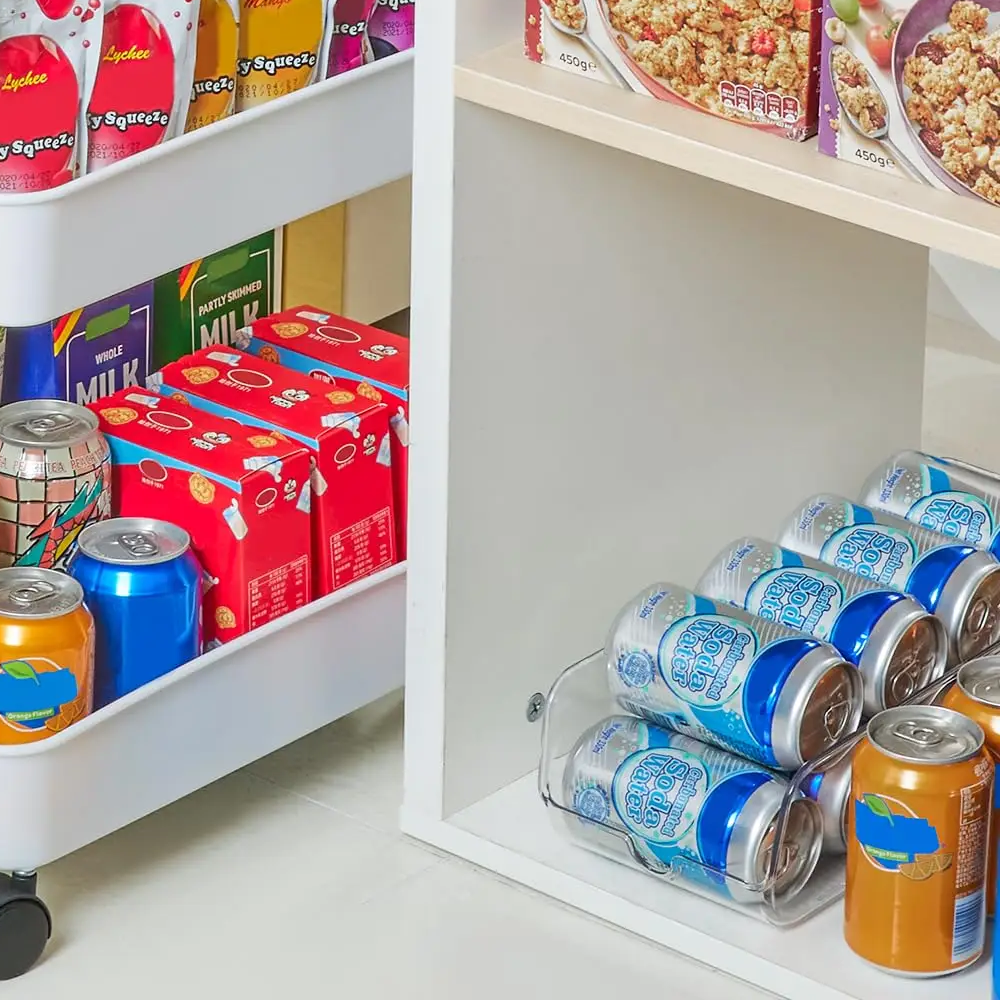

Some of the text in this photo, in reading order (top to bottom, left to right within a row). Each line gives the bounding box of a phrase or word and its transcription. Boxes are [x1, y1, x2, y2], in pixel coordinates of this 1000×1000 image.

[103, 45, 151, 65] Lychee
[253, 51, 317, 75] Squeeze
[2, 70, 48, 92] Lychee
[12, 132, 75, 159] Squeeze
[104, 110, 169, 132] Squeeze
[198, 279, 262, 317] PARTLY SKIMMED
[200, 300, 259, 349] MILK
[95, 344, 124, 365] WHOLE
[76, 358, 140, 406] MILK
[758, 571, 806, 621] Wate
[779, 576, 824, 630] Sod
[672, 619, 720, 688] Water
[688, 624, 738, 692] Soda
[706, 633, 750, 701] Carbonated
[625, 753, 673, 824] Water
[643, 758, 690, 828] Soda
[661, 767, 703, 837] Carbonated
